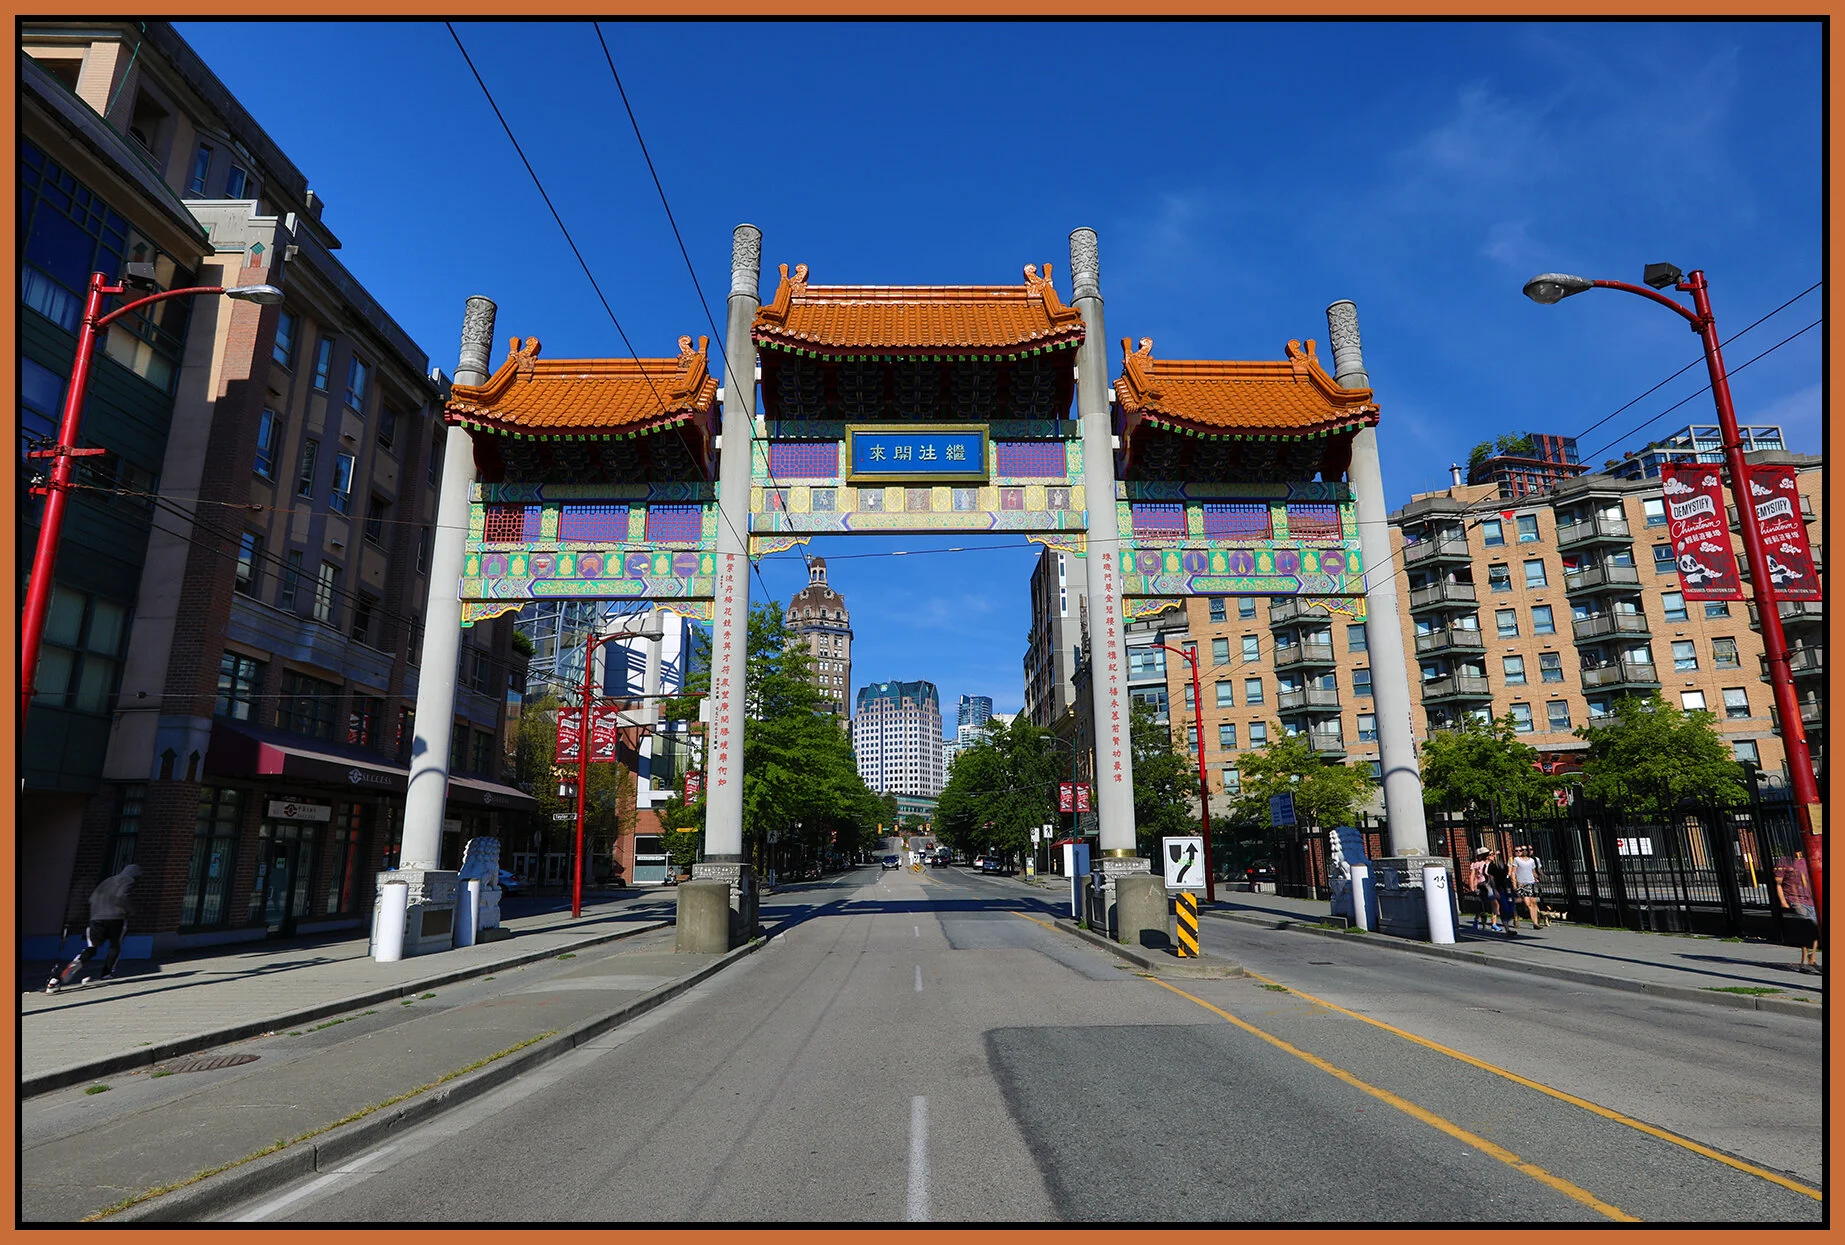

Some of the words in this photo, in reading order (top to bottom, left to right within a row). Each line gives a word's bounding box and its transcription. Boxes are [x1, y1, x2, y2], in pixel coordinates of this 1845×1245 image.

[1673, 498, 1709, 518] DEMYSTIFY
[1756, 500, 1788, 518] EMYSTIFY
[1671, 517, 1721, 538] Chinatown
[1759, 518, 1799, 536] hinatown
